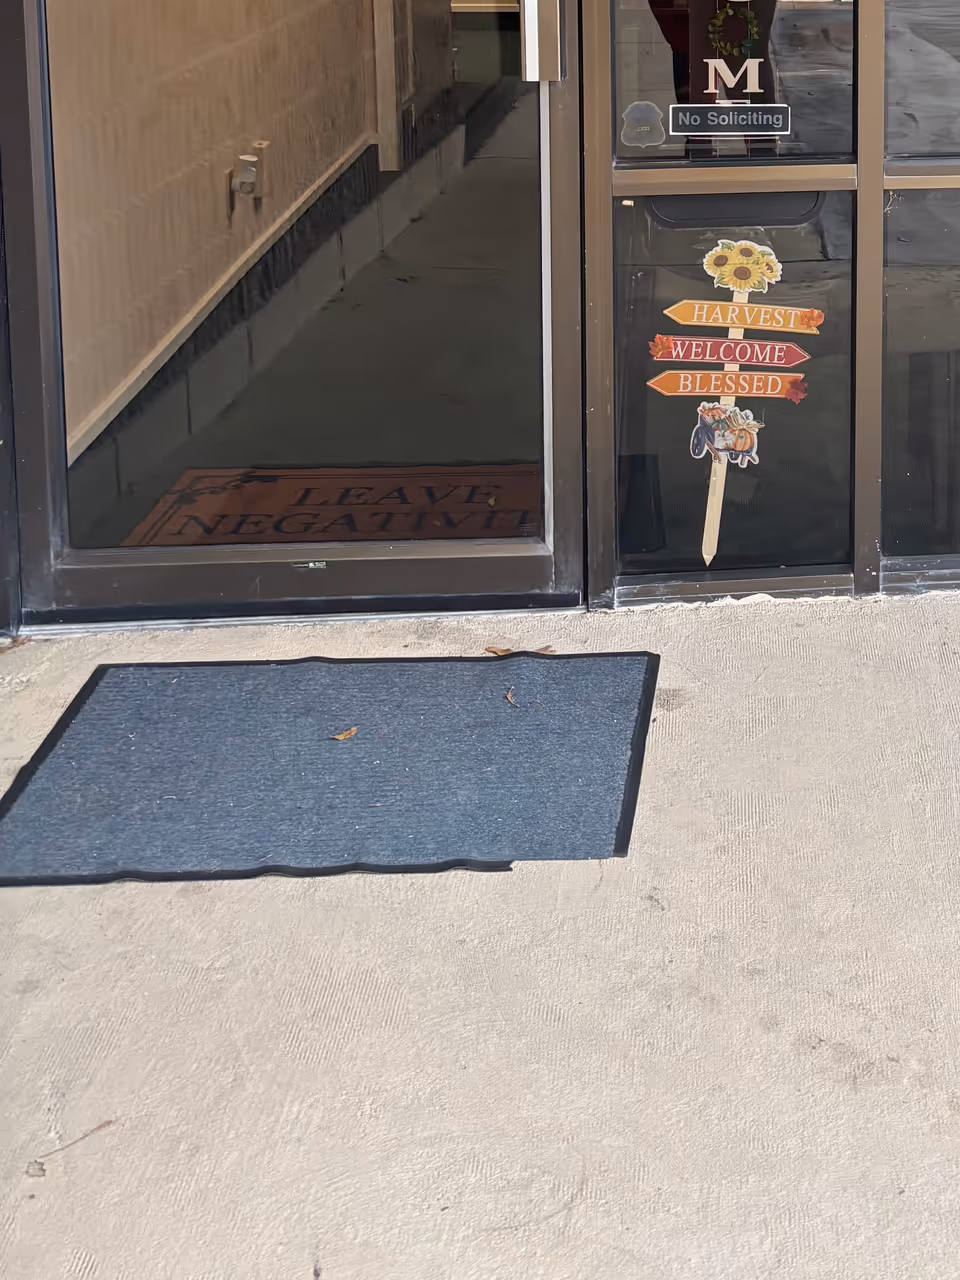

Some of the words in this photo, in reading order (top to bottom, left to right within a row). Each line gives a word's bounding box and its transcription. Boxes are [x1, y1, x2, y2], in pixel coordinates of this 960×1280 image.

[678, 112, 700, 126] No
[706, 111, 783, 129] Soliciting
[692, 303, 800, 329] HARVEST
[670, 340, 787, 364] WELCOME
[677, 373, 782, 395] BLESSED
[287, 485, 502, 507] LEAVE
